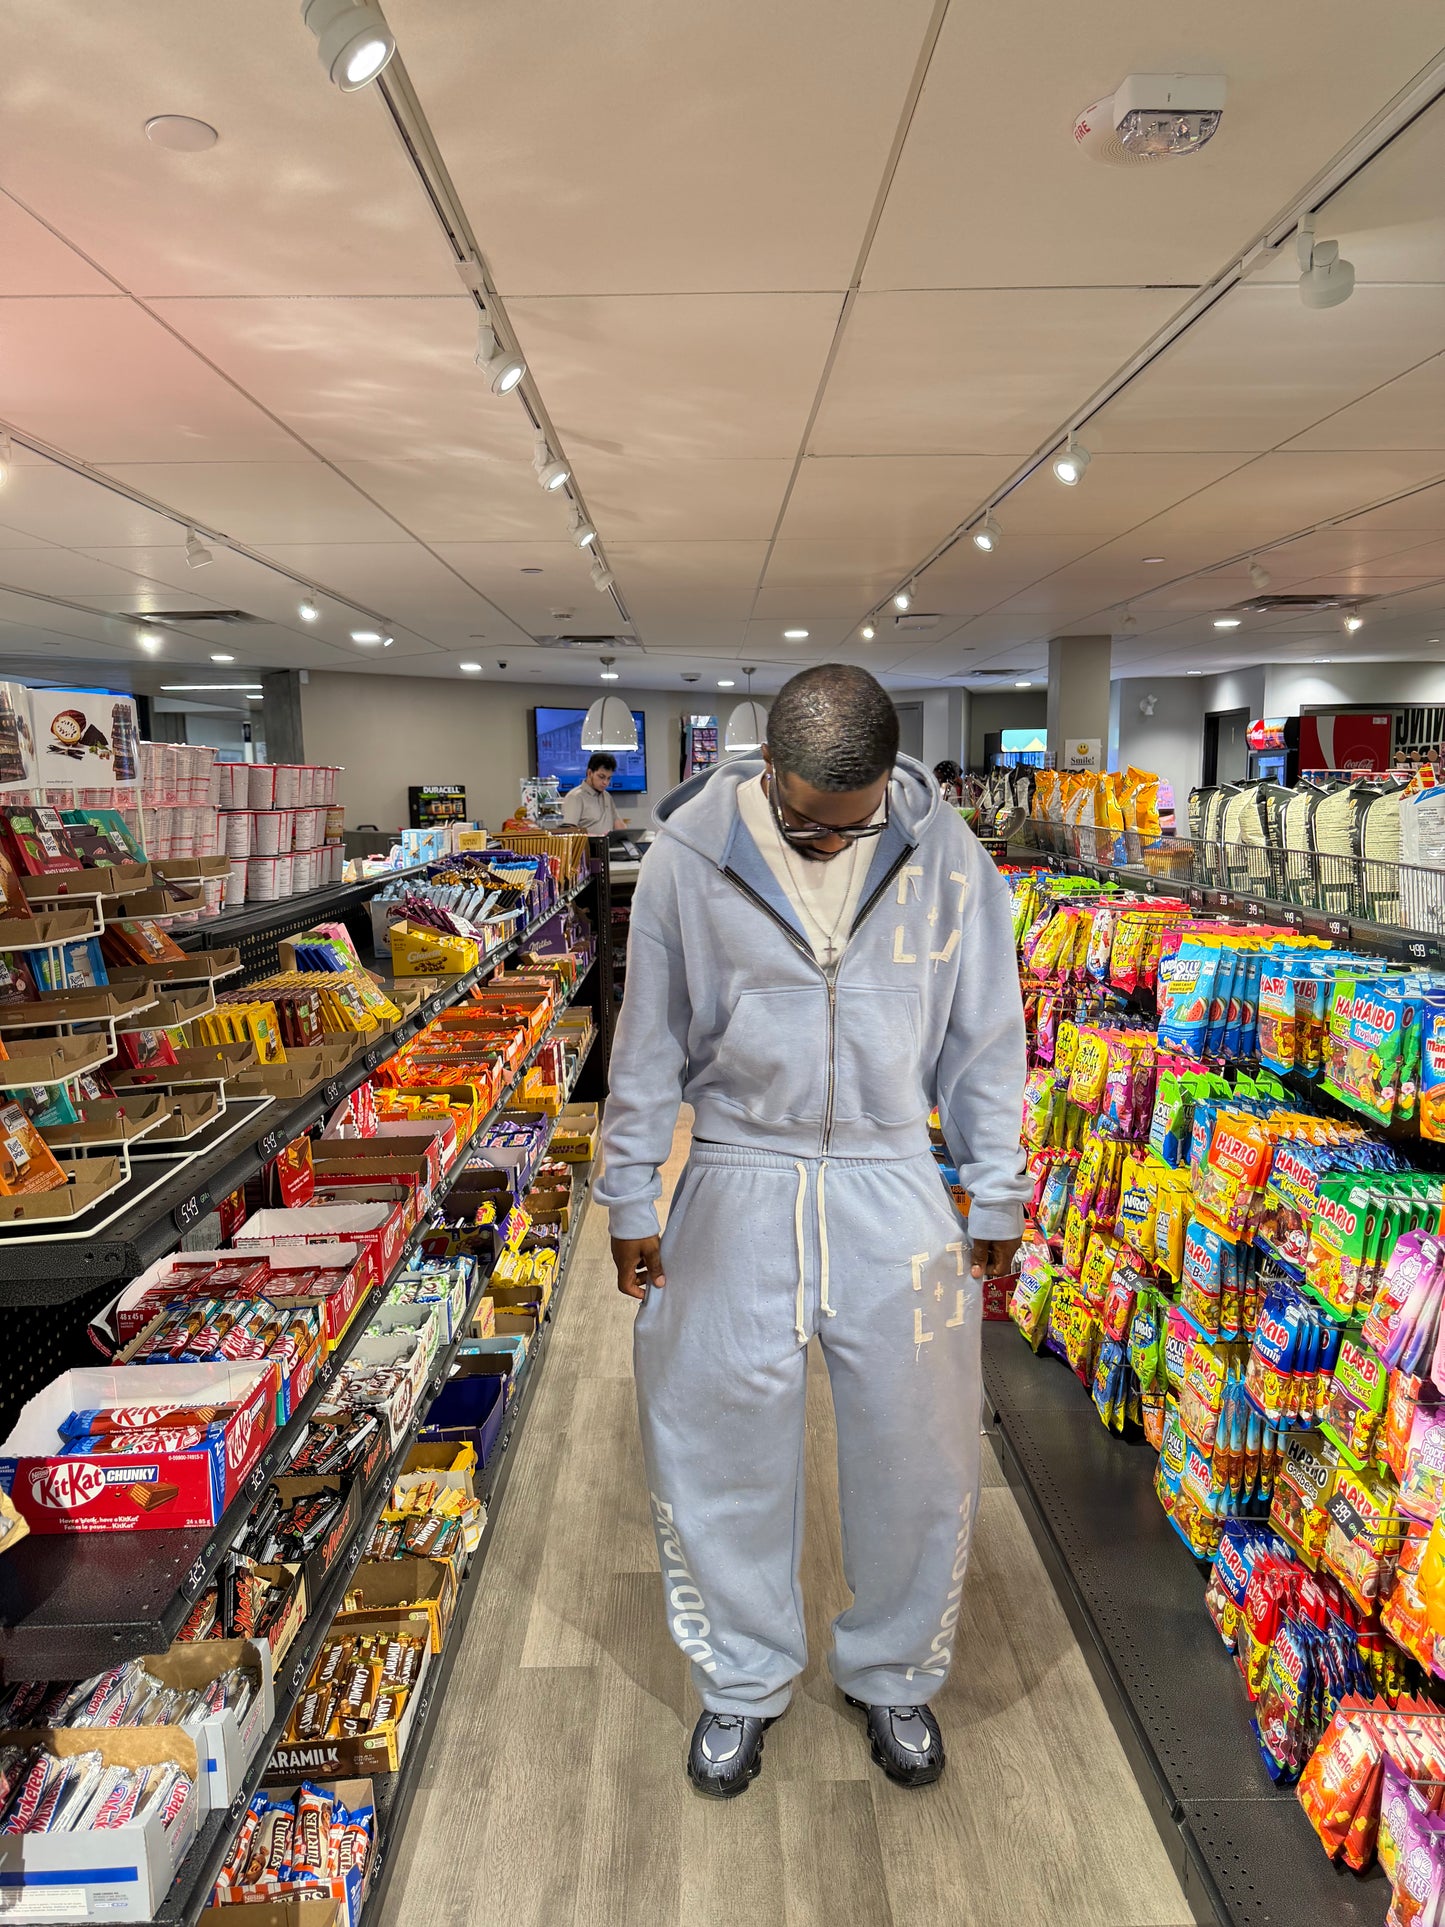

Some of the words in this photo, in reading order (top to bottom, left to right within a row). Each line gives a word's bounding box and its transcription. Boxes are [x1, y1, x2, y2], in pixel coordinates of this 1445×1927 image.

[1074, 120, 1091, 144] FIRE
[1070, 756, 1095, 765] Smile!
[423, 786, 460, 794] DURACELL
[529, 939, 552, 951] Milka
[1409, 944, 1425, 957] 499
[263, 1132, 276, 1153] 549
[1275, 1150, 1318, 1192] HARIBO
[181, 1196, 198, 1223] 549
[1299, 1193, 1313, 1209] ZING
[1123, 1269, 1138, 1281] 449
[1166, 1337, 1186, 1353] JOLLY
[117, 1404, 176, 1427] KitKat
[39, 1463, 103, 1507] KitKat
[107, 1467, 156, 1482] CHUNKY
[250, 1463, 265, 1492] 329
[1286, 1462, 1318, 1500] Goldbears
[1332, 1500, 1351, 1523] 399
[188, 1556, 207, 1589] 329
[1275, 1628, 1302, 1683] HARIBO
[349, 1669, 370, 1706] CARAMILK
[268, 1748, 339, 1769] ARAMILK
[8, 1759, 48, 1834] Musketeers
[270, 1819, 290, 1870] TURTLES
[306, 1812, 320, 1866] TURTLES
